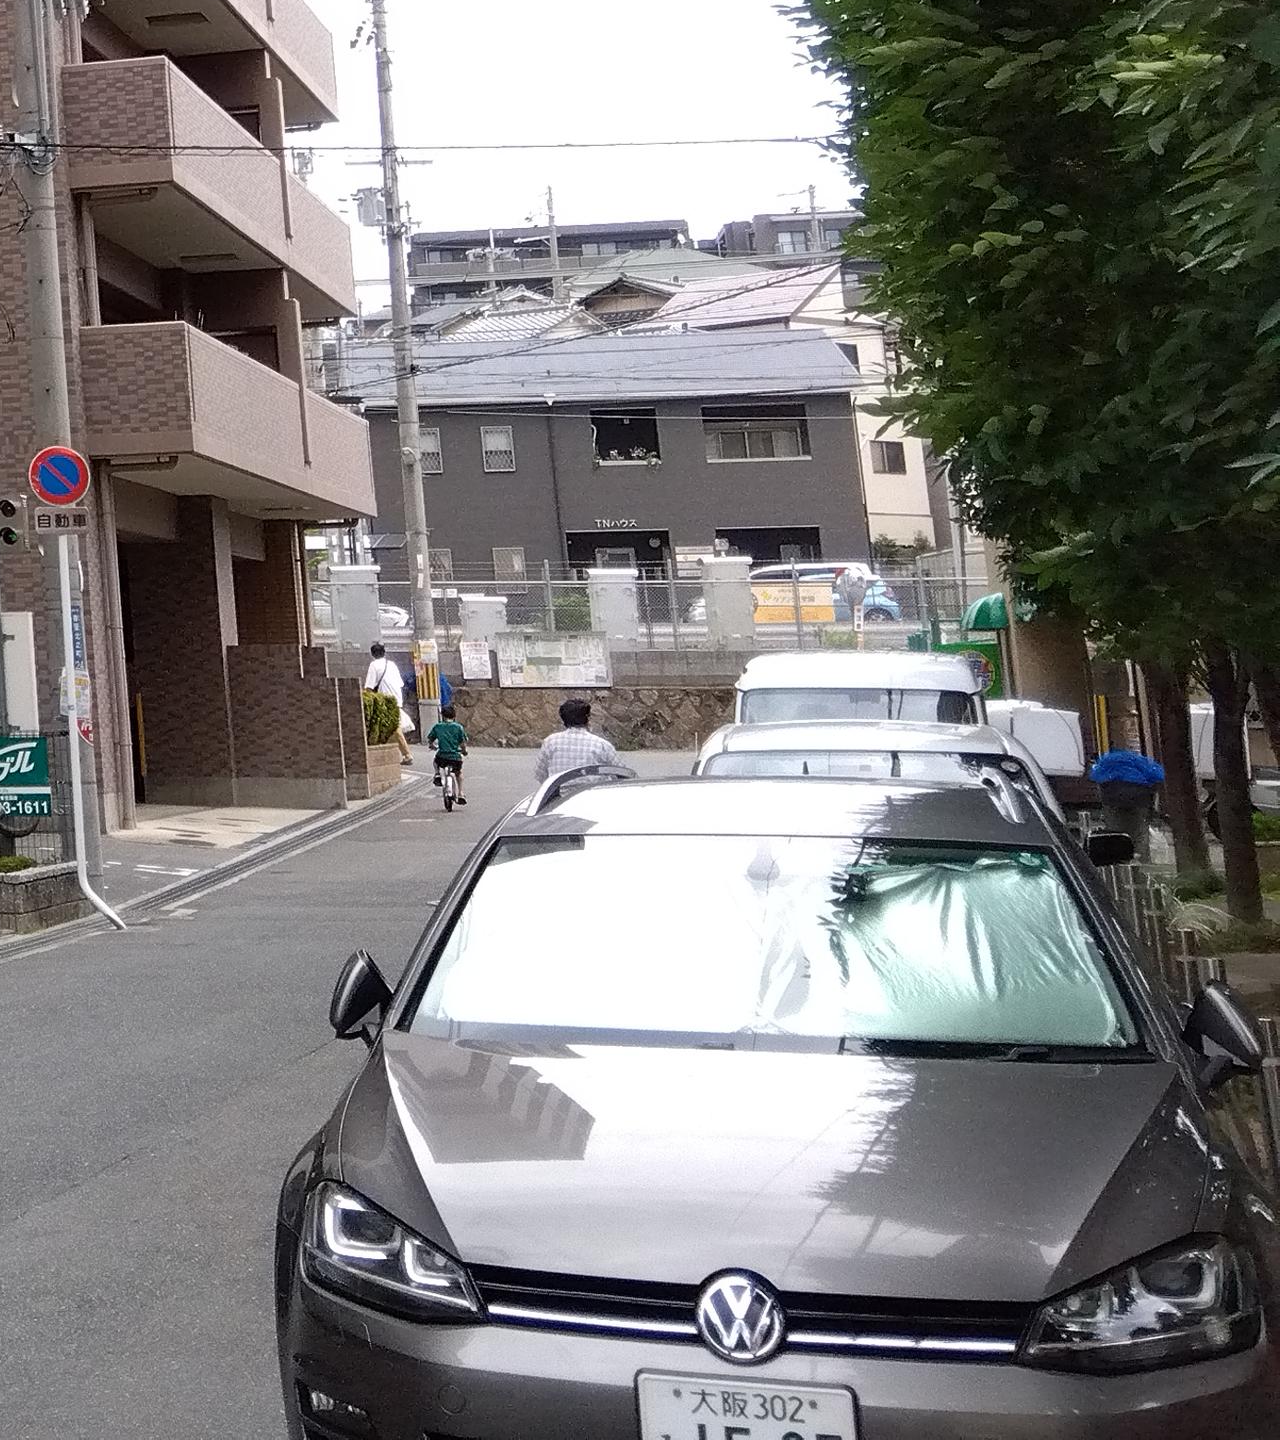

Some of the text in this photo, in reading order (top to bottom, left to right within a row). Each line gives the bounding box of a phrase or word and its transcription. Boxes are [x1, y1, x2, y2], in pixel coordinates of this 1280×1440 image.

[37, 513, 87, 529] 自動車
[594, 518, 638, 528] TNハウス
[690, 1389, 806, 1424] 大阪302
